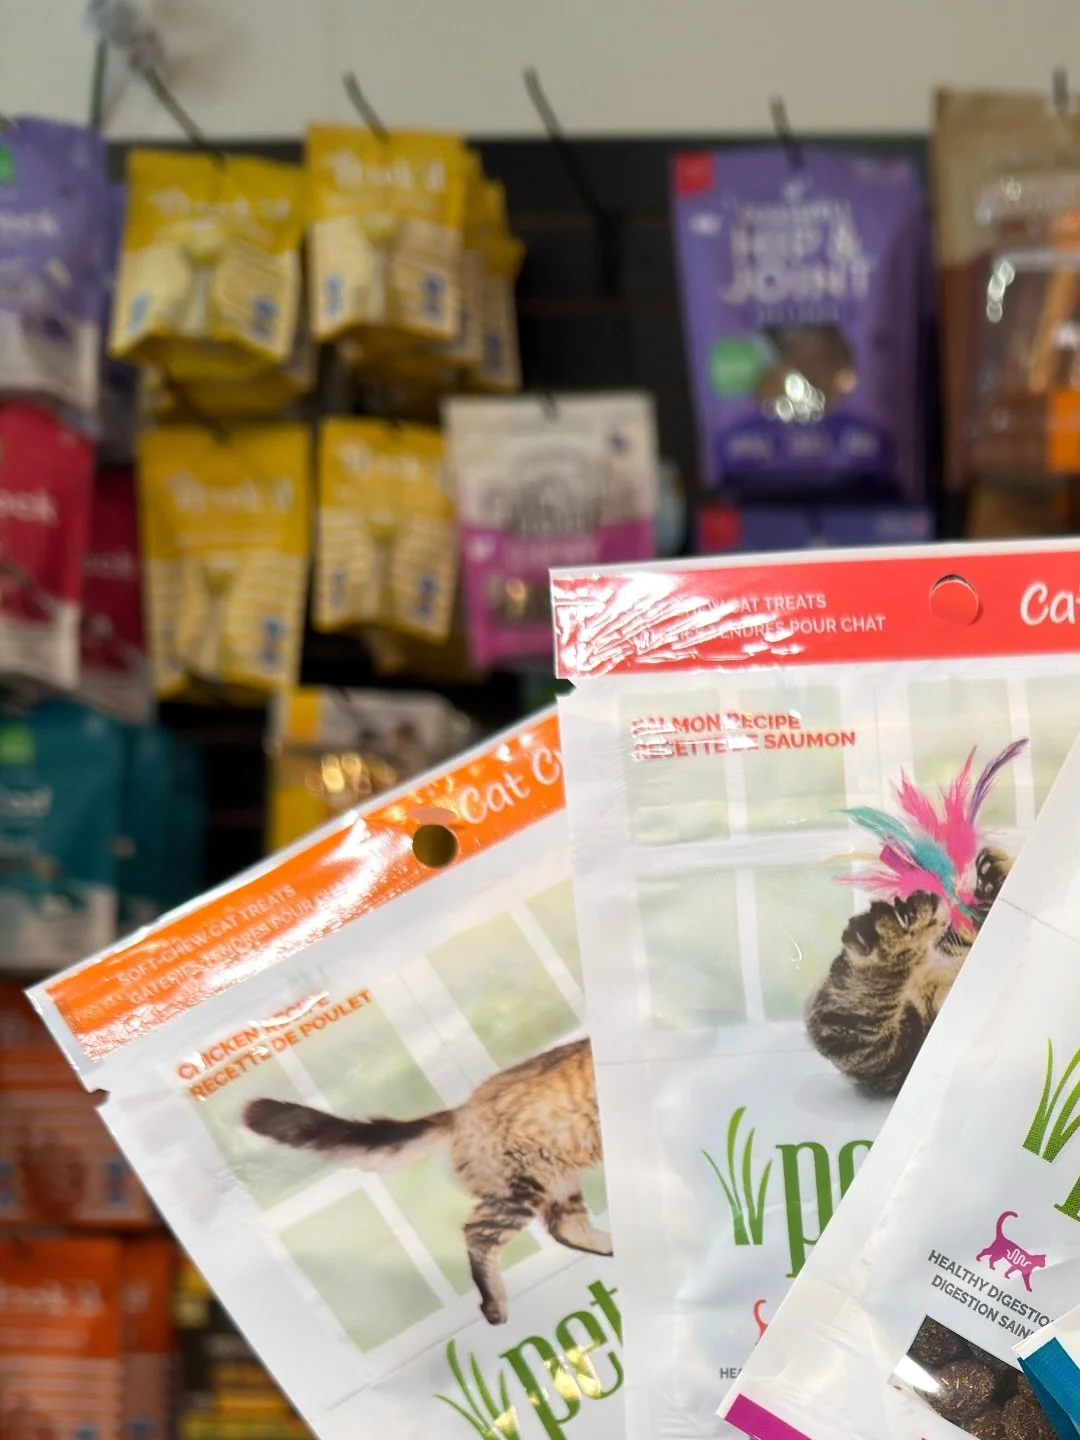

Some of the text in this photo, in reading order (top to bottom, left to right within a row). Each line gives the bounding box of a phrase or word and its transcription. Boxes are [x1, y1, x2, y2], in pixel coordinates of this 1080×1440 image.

[766, 592, 827, 611] TREATS
[790, 617, 836, 635] POUR
[840, 615, 886, 634] CHAT
[764, 731, 856, 750] SAUMON
[459, 773, 531, 824] Cat
[116, 930, 209, 986] SOFT-CHEW
[209, 914, 239, 938] CAT
[241, 884, 297, 921] TREATS
[268, 899, 314, 930] POUR
[271, 1030, 299, 1053] DE
[298, 988, 372, 1040] POULET
[928, 1249, 990, 1292] HEALTHY
[931, 1275, 999, 1323] DIGESTION
